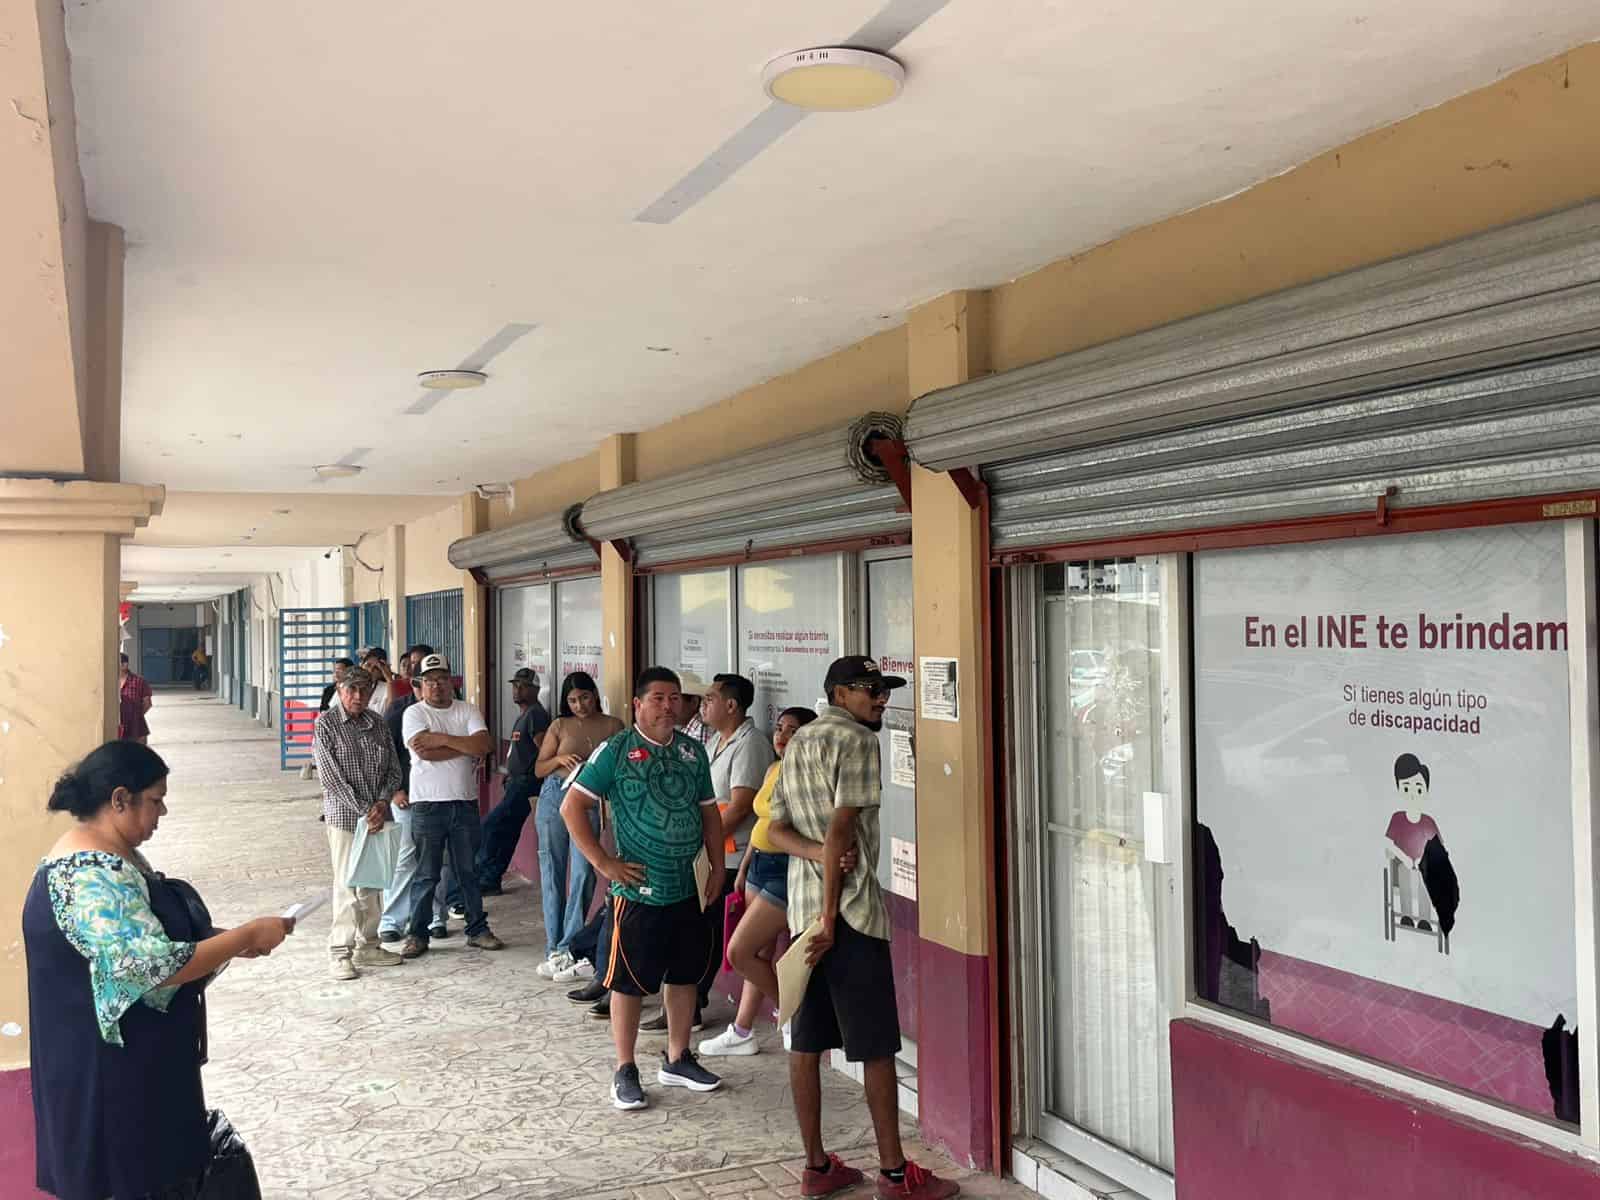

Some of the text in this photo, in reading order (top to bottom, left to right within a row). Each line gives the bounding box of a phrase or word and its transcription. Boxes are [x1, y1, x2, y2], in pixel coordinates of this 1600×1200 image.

[1245, 616, 1276, 648] En
[1284, 615, 1308, 648] el
[1317, 615, 1368, 649] INE
[1376, 614, 1408, 649] te
[1343, 684, 1488, 713] Si tienes algún tipo
[1348, 708, 1481, 735] de discapacidad
